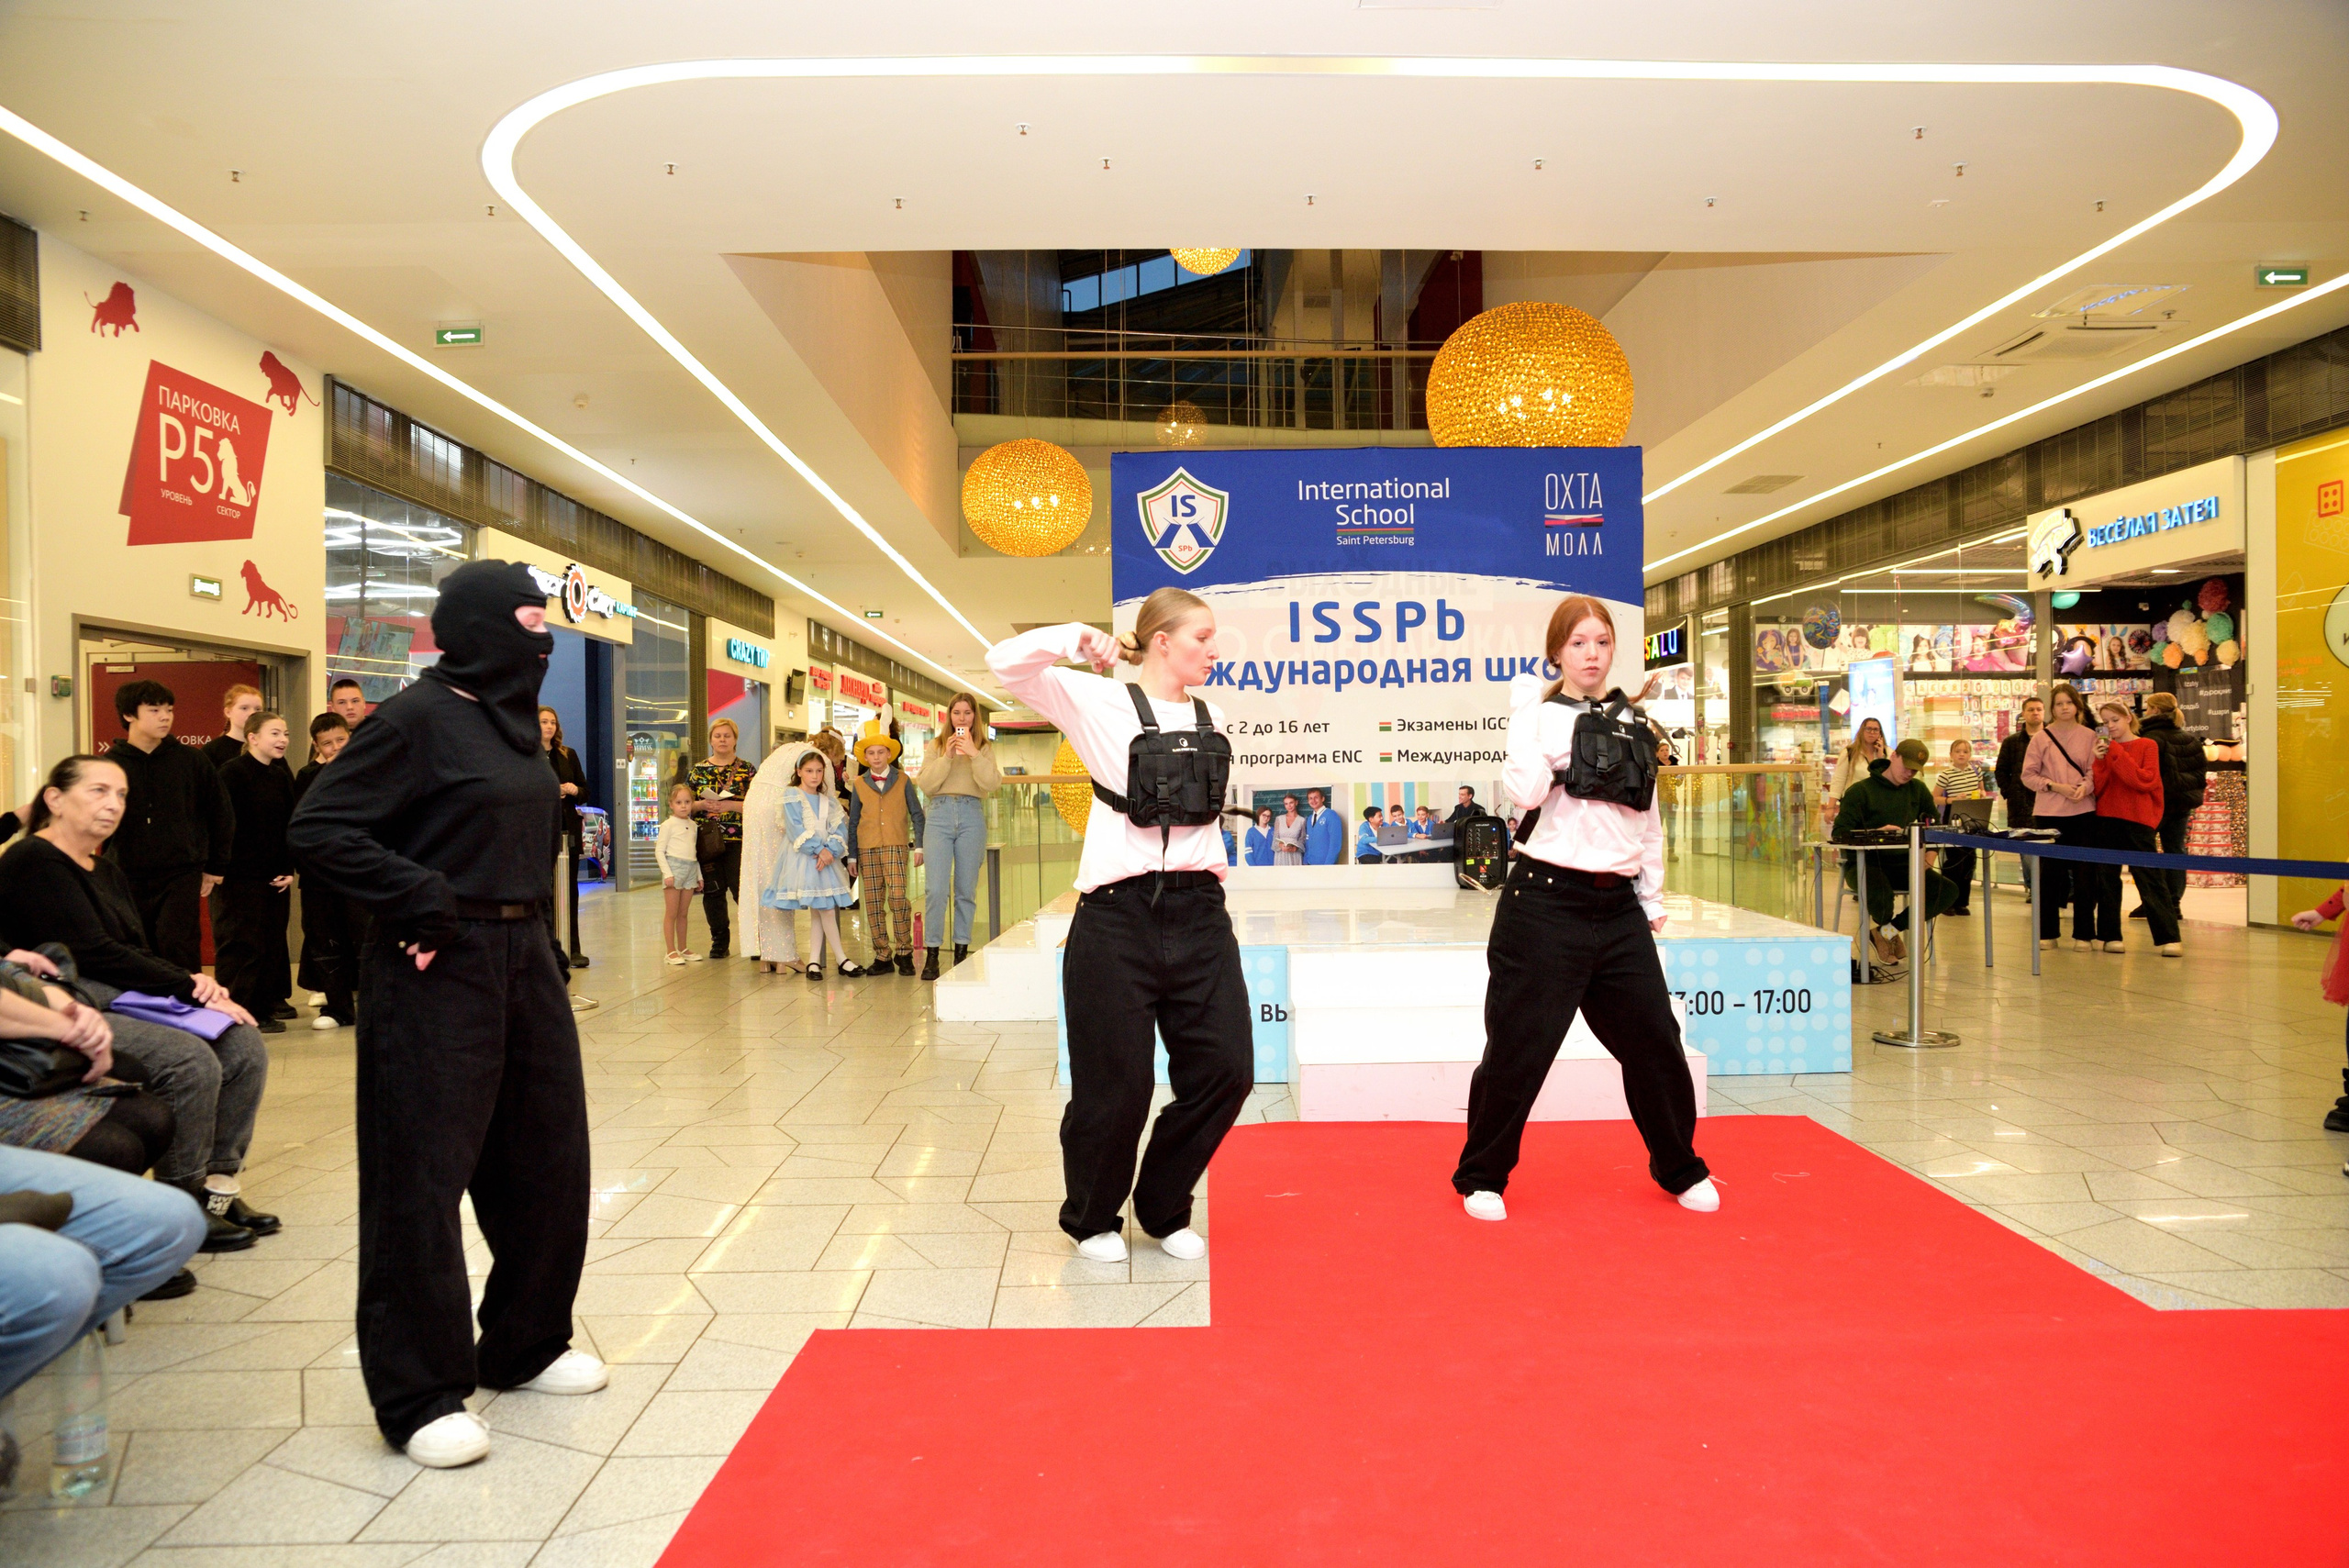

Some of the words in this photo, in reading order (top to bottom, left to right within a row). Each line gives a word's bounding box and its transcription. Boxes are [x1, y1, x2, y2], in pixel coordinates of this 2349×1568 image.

[159, 384, 240, 435] ПАРКОВКА
[160, 488, 193, 506] УРОВЕНЬ
[1298, 477, 1450, 501] International
[1545, 473, 1603, 510] ОХТА
[217, 505, 241, 519] СЕКТОР
[1171, 495, 1197, 517] IS
[1336, 503, 1415, 526] School
[2087, 511, 2158, 549] ВЕСЁЛАЯ
[2161, 495, 2220, 530] ЗАТЕЯ
[1336, 535, 1361, 546] Saint
[1363, 535, 1415, 546] Petersburg
[730, 638, 755, 664] CRAZY
[755, 647, 770, 668] ТИР
[1204, 657, 1472, 694] ждународная
[1485, 657, 1563, 682] шко
[1239, 720, 1248, 734] 2
[1252, 723, 1273, 736] до
[1278, 719, 1298, 734] 16
[1303, 722, 1330, 733] лет
[1397, 718, 1478, 732] Экзамены
[1483, 717, 1509, 730] IGC
[1240, 752, 1327, 767] программа
[1332, 750, 1363, 763] ENC
[1397, 749, 1508, 765] Международн
[1753, 988, 1811, 1014] 17:00
